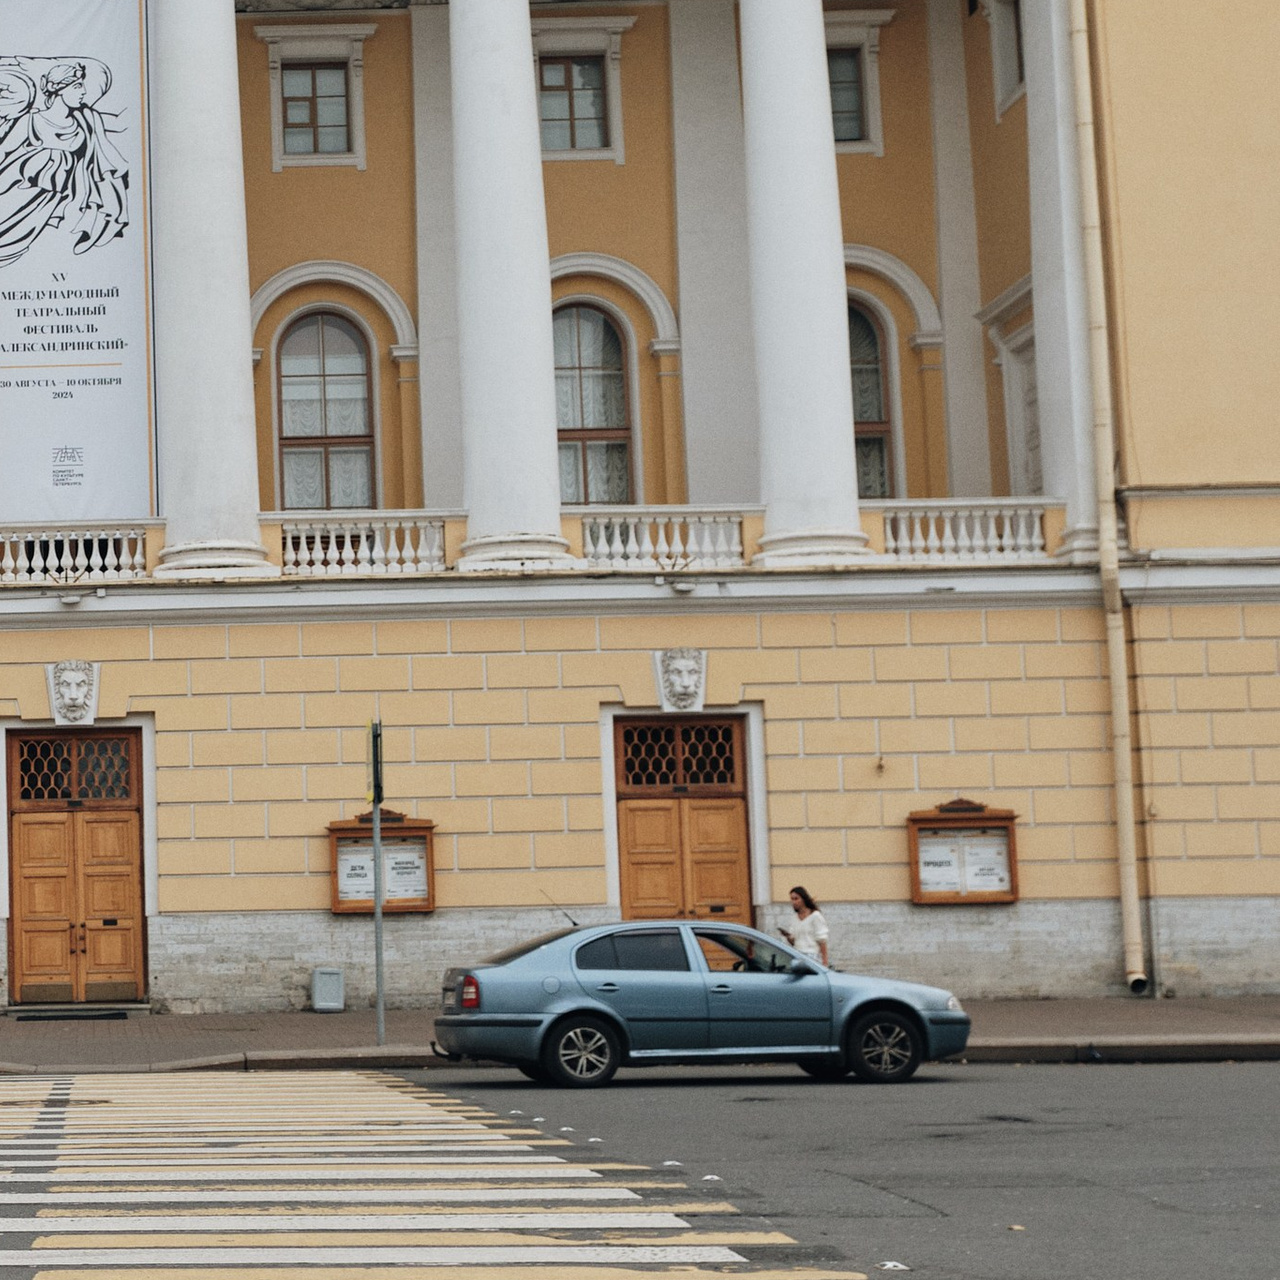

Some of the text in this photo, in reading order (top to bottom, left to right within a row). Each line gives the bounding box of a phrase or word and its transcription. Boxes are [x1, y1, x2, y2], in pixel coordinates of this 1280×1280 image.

[1, 286, 120, 301] МЕЖДУНАРОДНЫЙ
[15, 304, 107, 318] ТЕАТРАЛЬНЫЙ
[23, 324, 99, 335] ФЕСТИВАЛЬ
[0, 380, 12, 389] 30
[14, 379, 57, 388] АВГУСТА
[66, 378, 77, 387] 10
[77, 377, 122, 387] ОКТЯБРЯ
[52, 391, 74, 400] 2024
